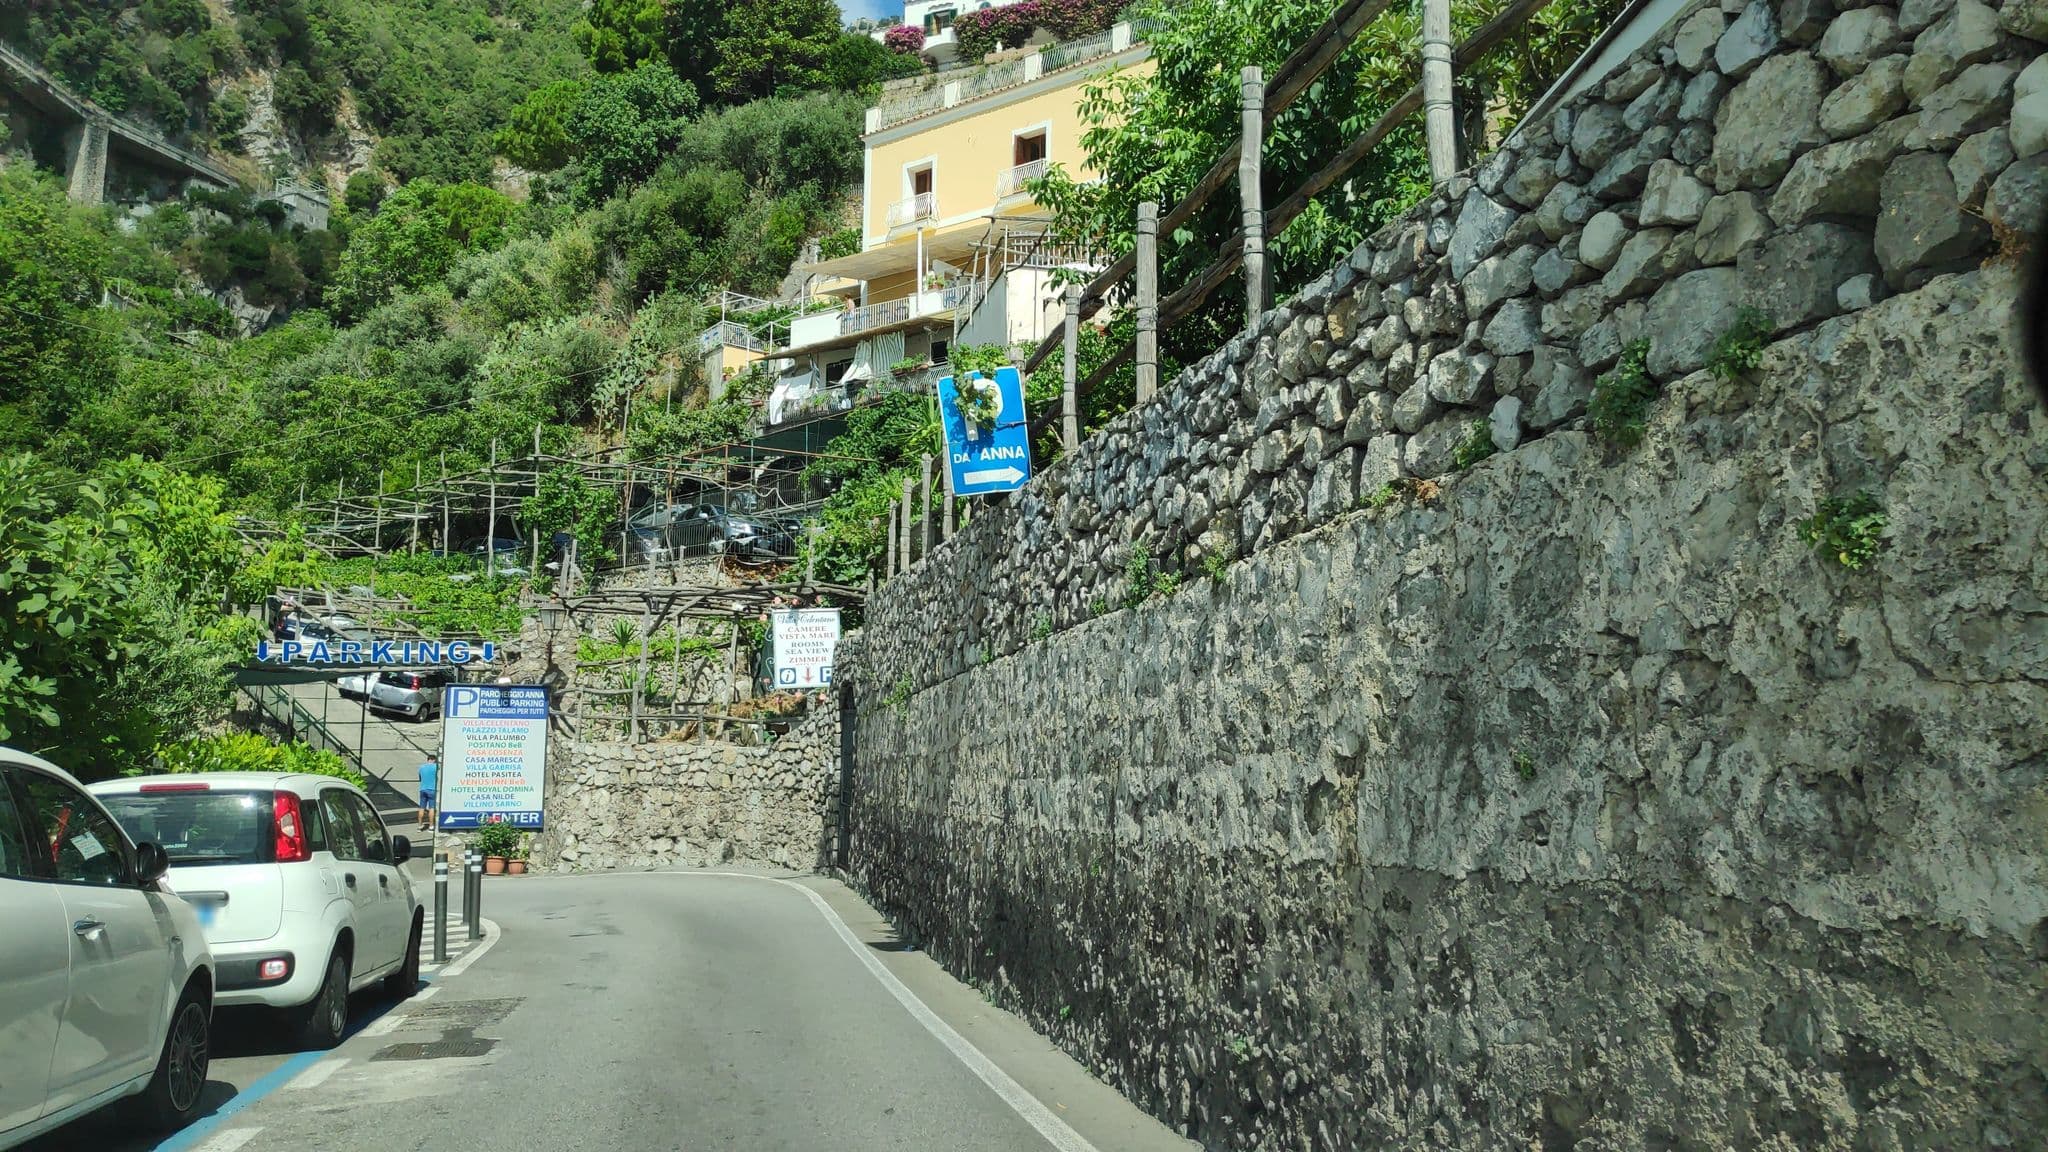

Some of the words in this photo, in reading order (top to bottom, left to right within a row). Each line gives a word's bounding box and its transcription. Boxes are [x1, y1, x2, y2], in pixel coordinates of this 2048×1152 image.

[954, 454, 970, 464] DA
[980, 446, 1026, 461] ANNA
[282, 640, 472, 664] PARKING
[452, 688, 478, 716] P
[492, 813, 539, 823] ENTER
